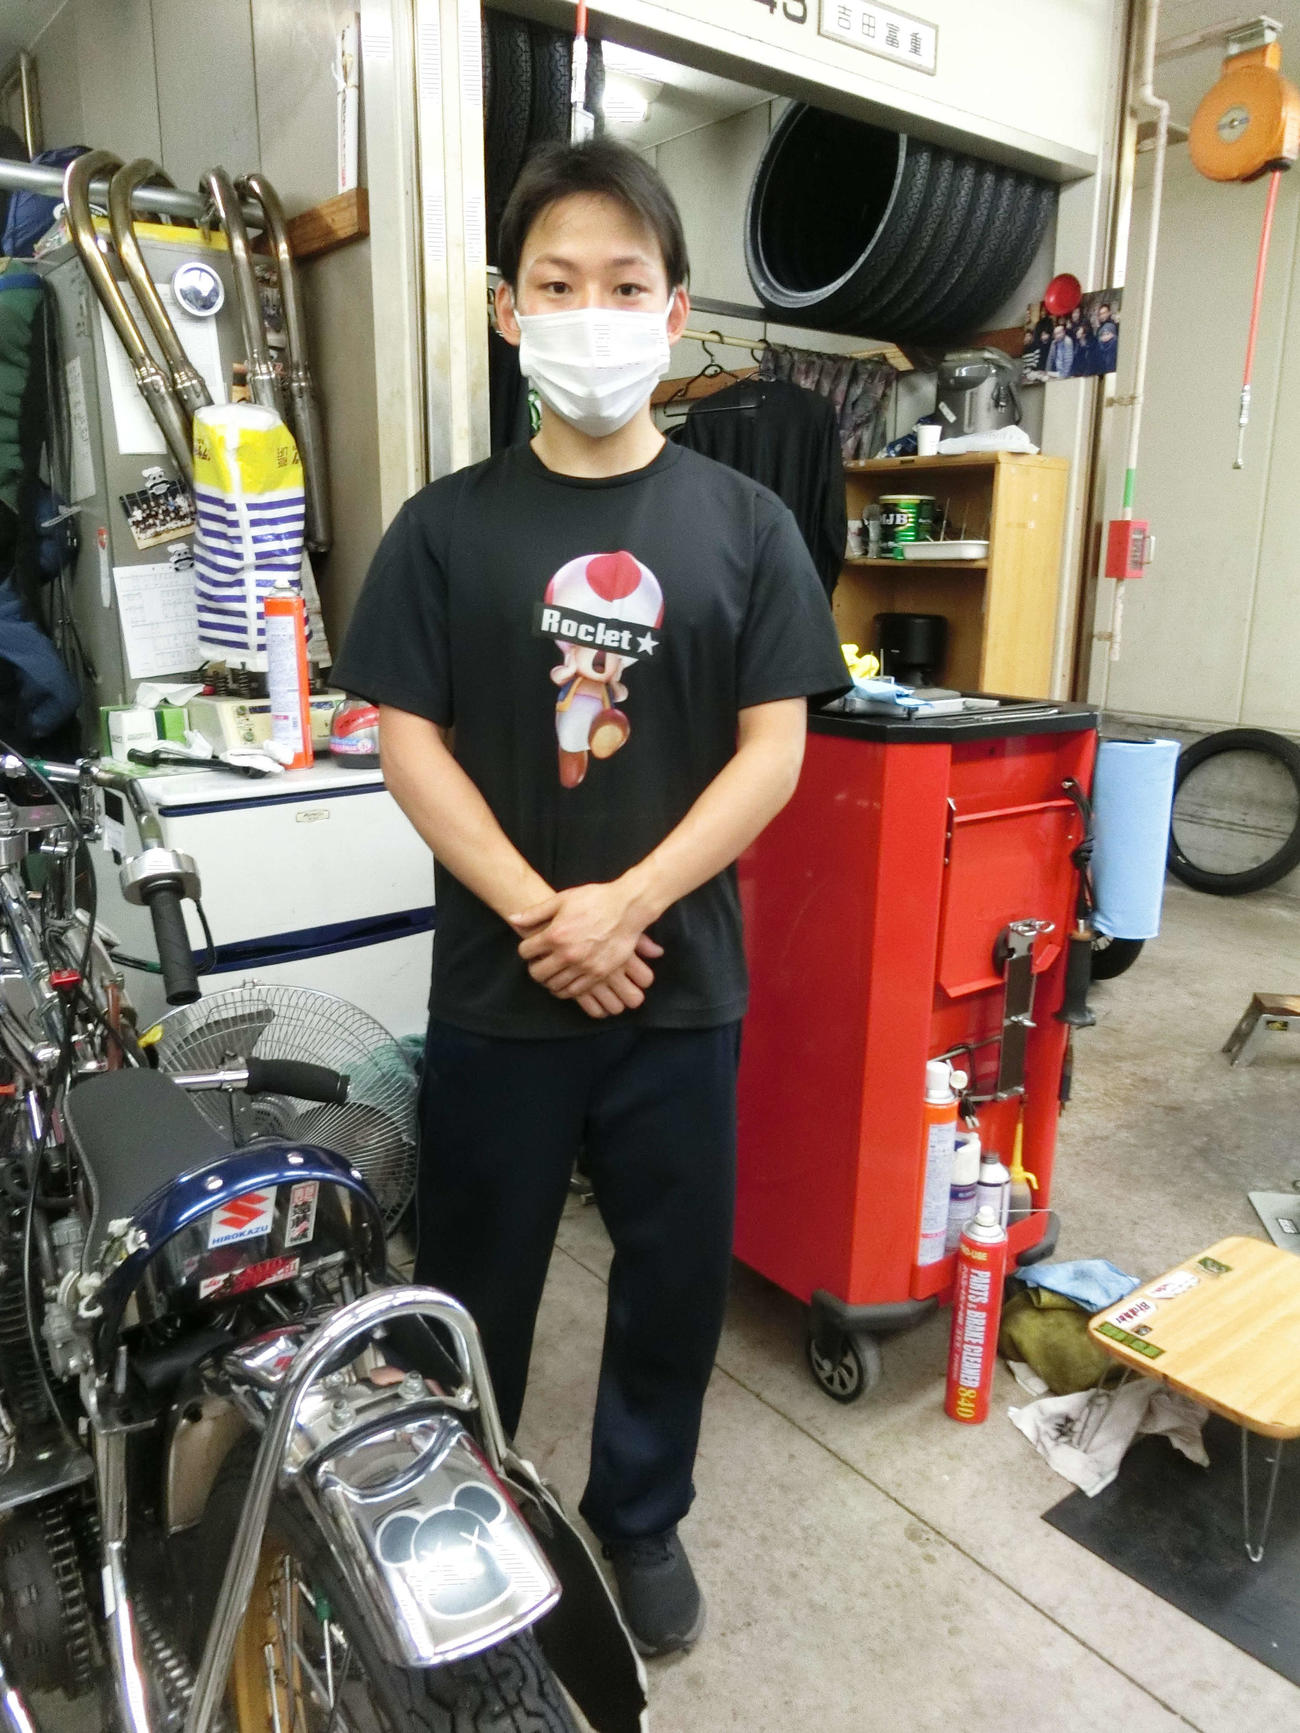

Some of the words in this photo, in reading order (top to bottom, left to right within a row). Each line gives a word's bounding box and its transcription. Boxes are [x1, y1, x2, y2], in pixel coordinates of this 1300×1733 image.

[212, 1225, 268, 1244] HIROKAZU
[969, 1269, 991, 1304] PARTS
[964, 1310, 987, 1344] BRAKE
[959, 1344, 983, 1388] CLEANER
[956, 1386, 976, 1418] 840
